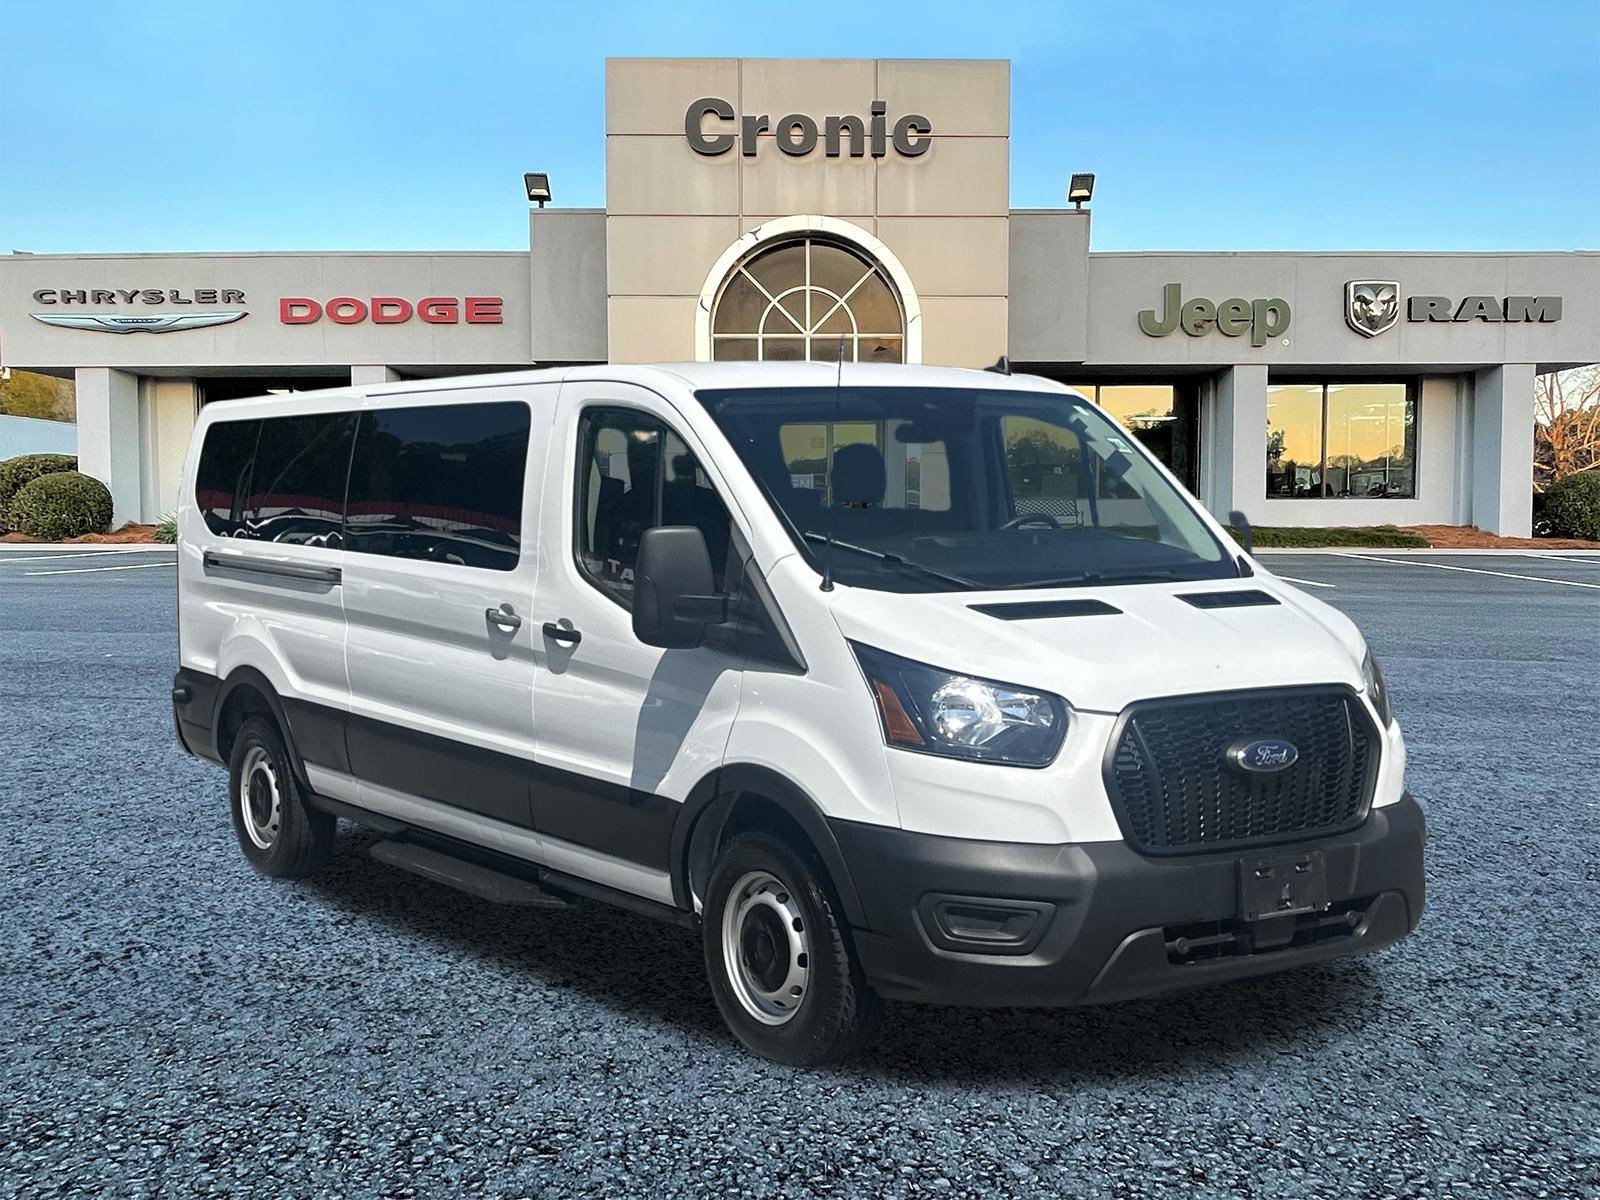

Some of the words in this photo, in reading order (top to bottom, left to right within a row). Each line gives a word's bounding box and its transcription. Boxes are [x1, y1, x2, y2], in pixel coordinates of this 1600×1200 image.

[684, 97, 932, 157] Cronic
[32, 288, 246, 304] CHRYSLER
[1407, 296, 1563, 323] RAM
[280, 297, 503, 324] DODGE
[1137, 283, 1291, 347] Jeep
[1255, 745, 1288, 766] Ford
